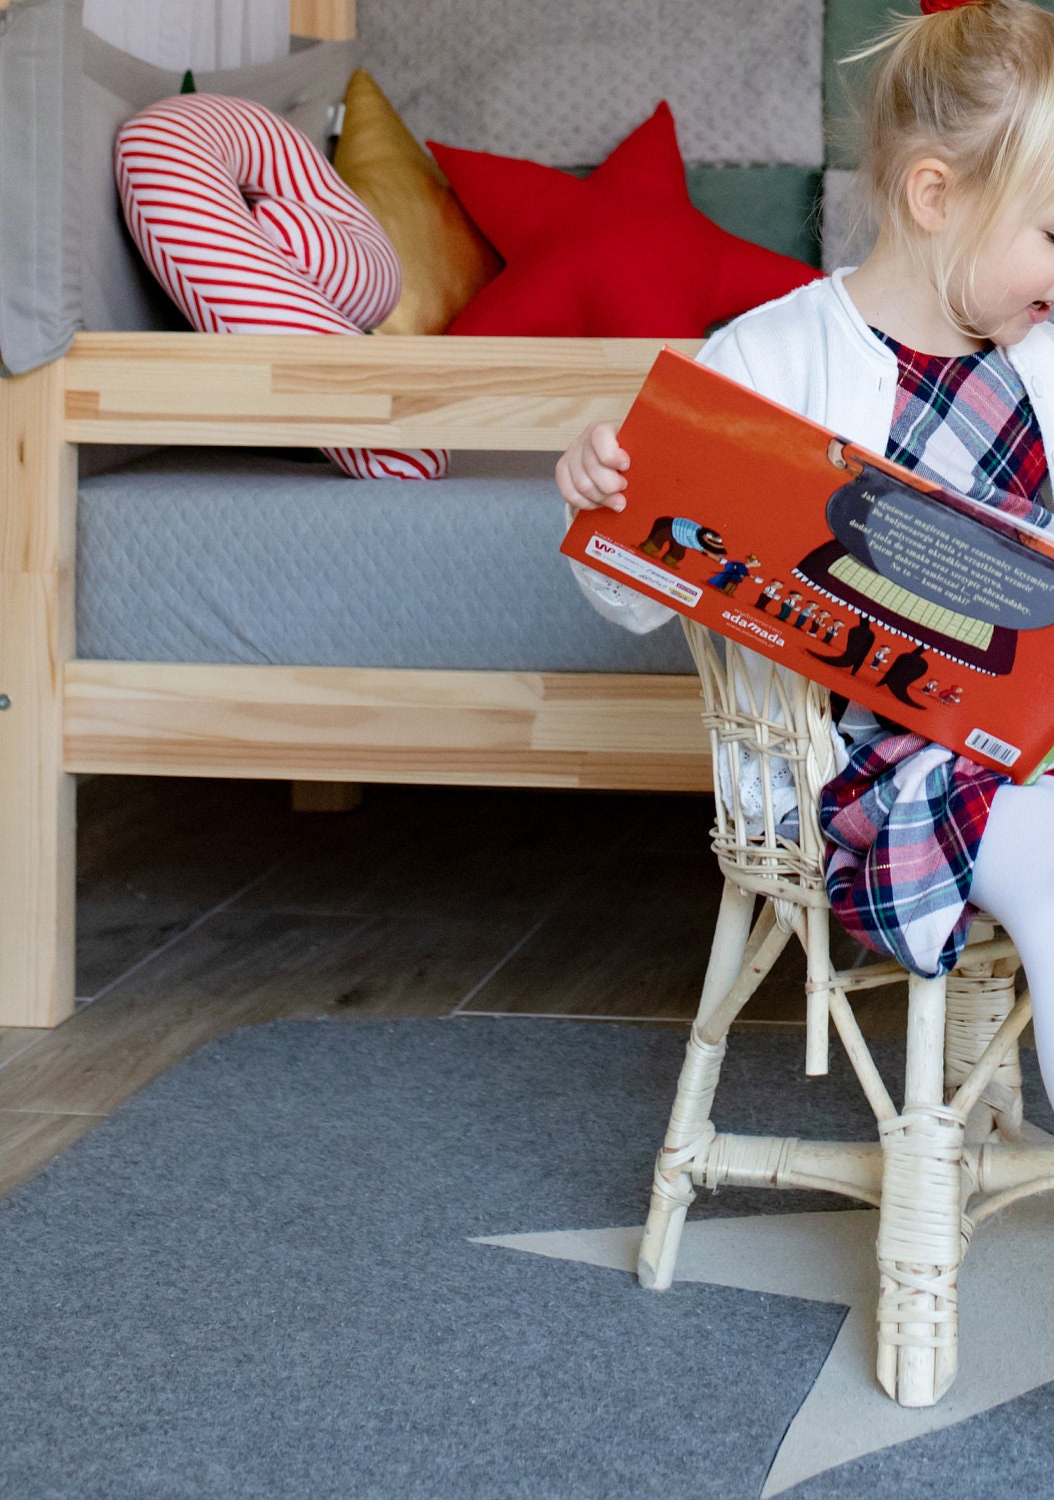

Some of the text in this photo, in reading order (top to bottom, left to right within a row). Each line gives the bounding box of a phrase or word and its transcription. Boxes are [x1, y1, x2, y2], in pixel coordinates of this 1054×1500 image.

[849, 518, 872, 534] dodać
[872, 530, 894, 546] zioła
[894, 540, 904, 550] do
[905, 547, 931, 564] smaku
[931, 561, 948, 574] oraz
[861, 490, 876, 502] Jak
[876, 499, 914, 522] ugotować
[913, 518, 950, 542] magiczną
[970, 546, 1012, 572] czarownicy
[872, 508, 883, 518] Do
[935, 538, 956, 554] kotła
[963, 554, 1003, 578] wrzątkiem
[868, 539, 893, 556] Potem
[894, 552, 920, 570] dobrze
[921, 566, 960, 589] zamieszać
[890, 562, 900, 572] No
[902, 568, 912, 576] to
[921, 577, 943, 592] komu
[943, 590, 970, 606] zupki?
[927, 547, 969, 572] ukradkiem
[721, 610, 786, 646] adamada
